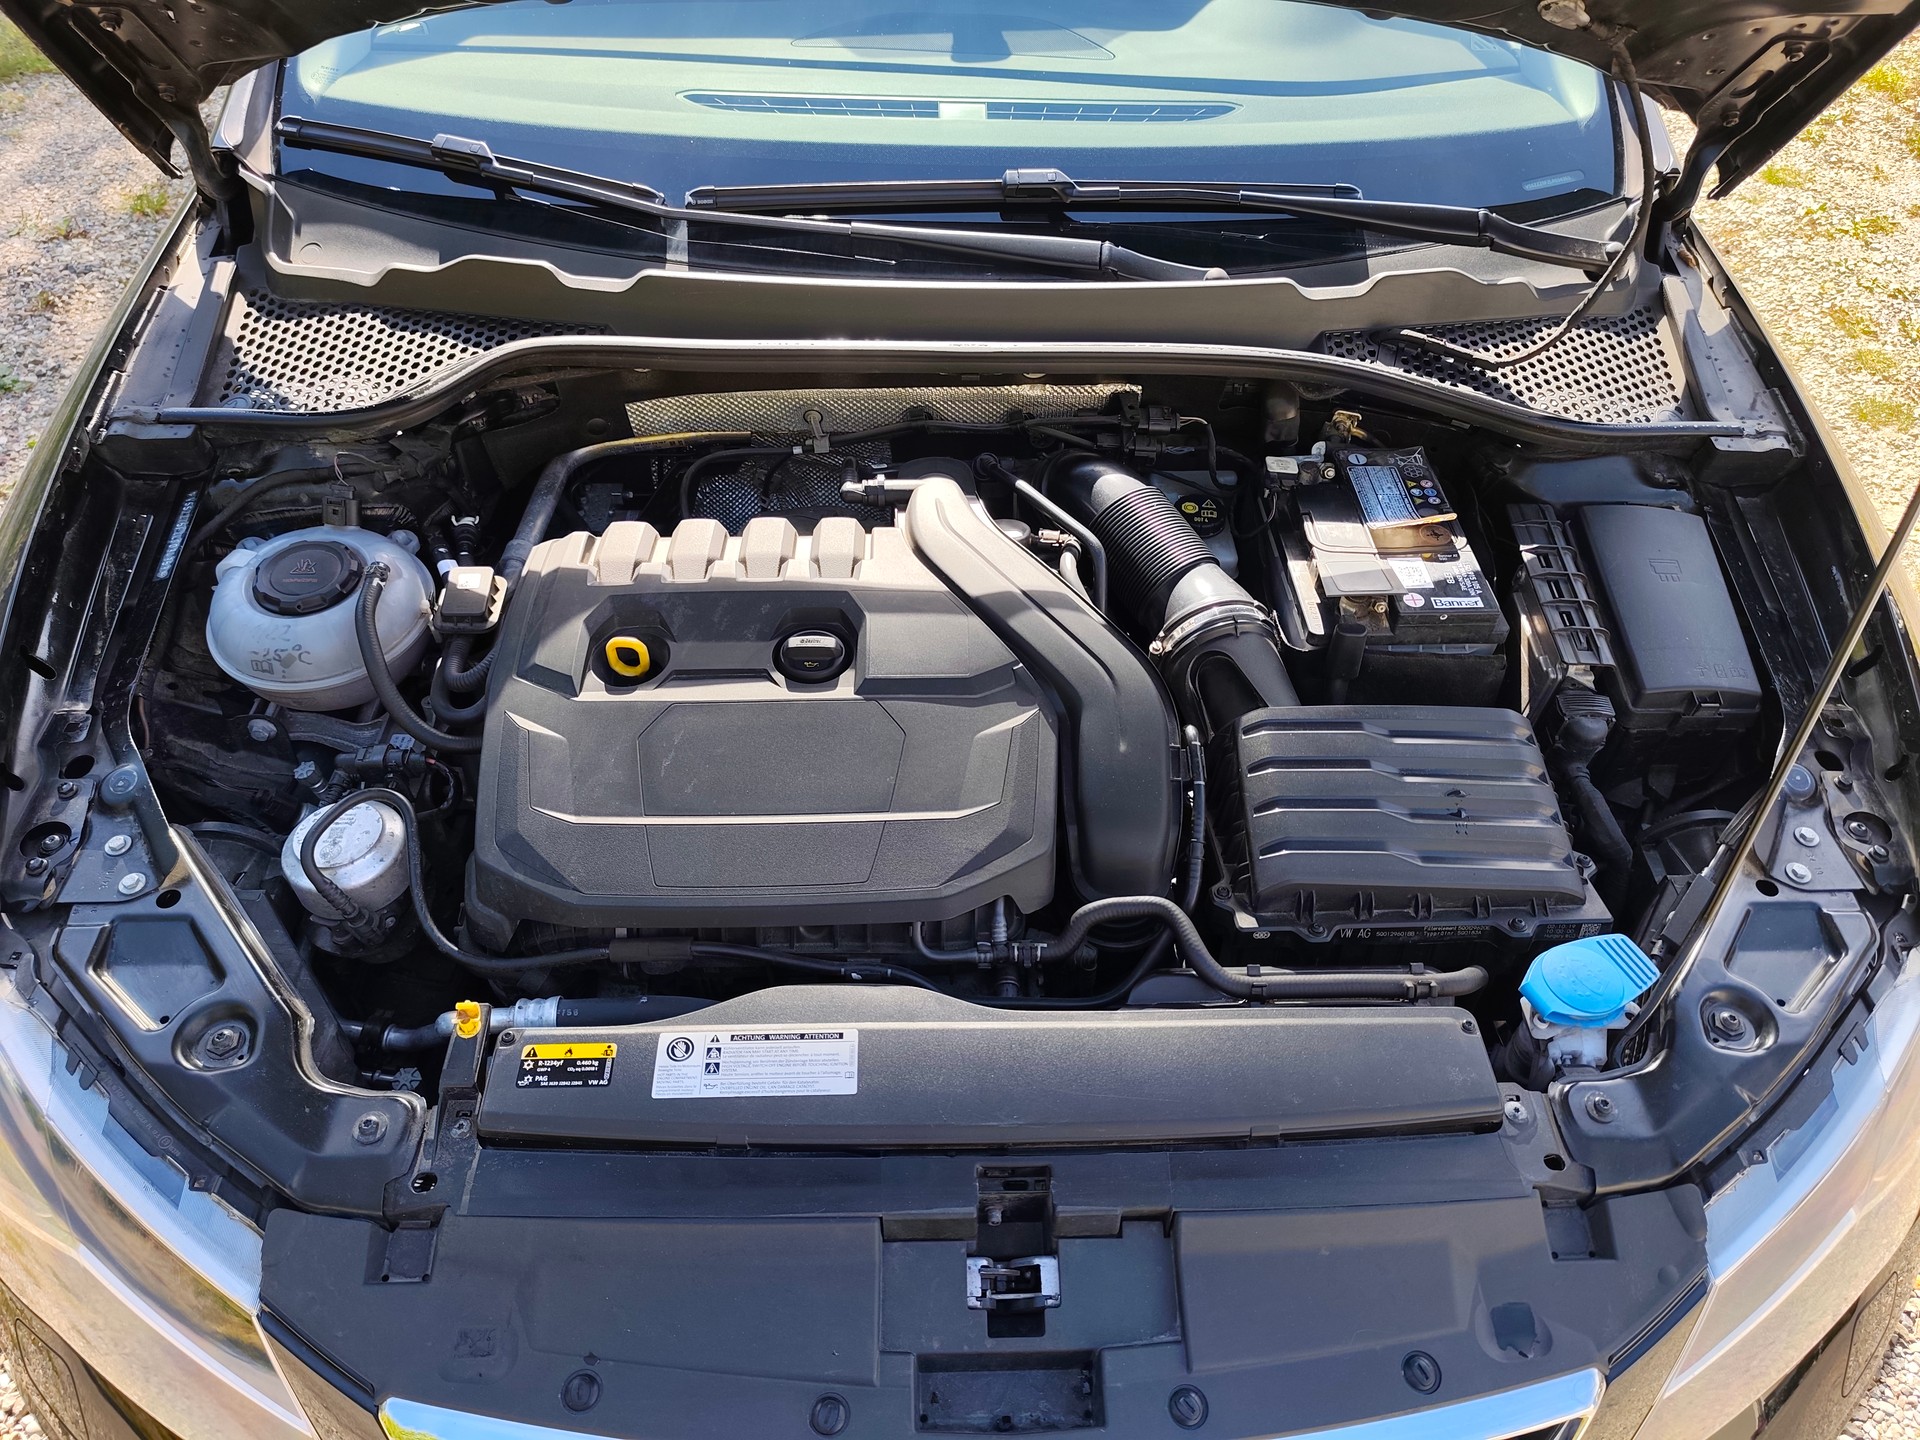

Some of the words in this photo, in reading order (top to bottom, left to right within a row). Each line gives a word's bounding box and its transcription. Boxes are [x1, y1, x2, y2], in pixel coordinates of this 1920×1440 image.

[1433, 599, 1480, 607] Banner
[1340, 928, 1352, 938] VW
[1357, 928, 1371, 938] AG
